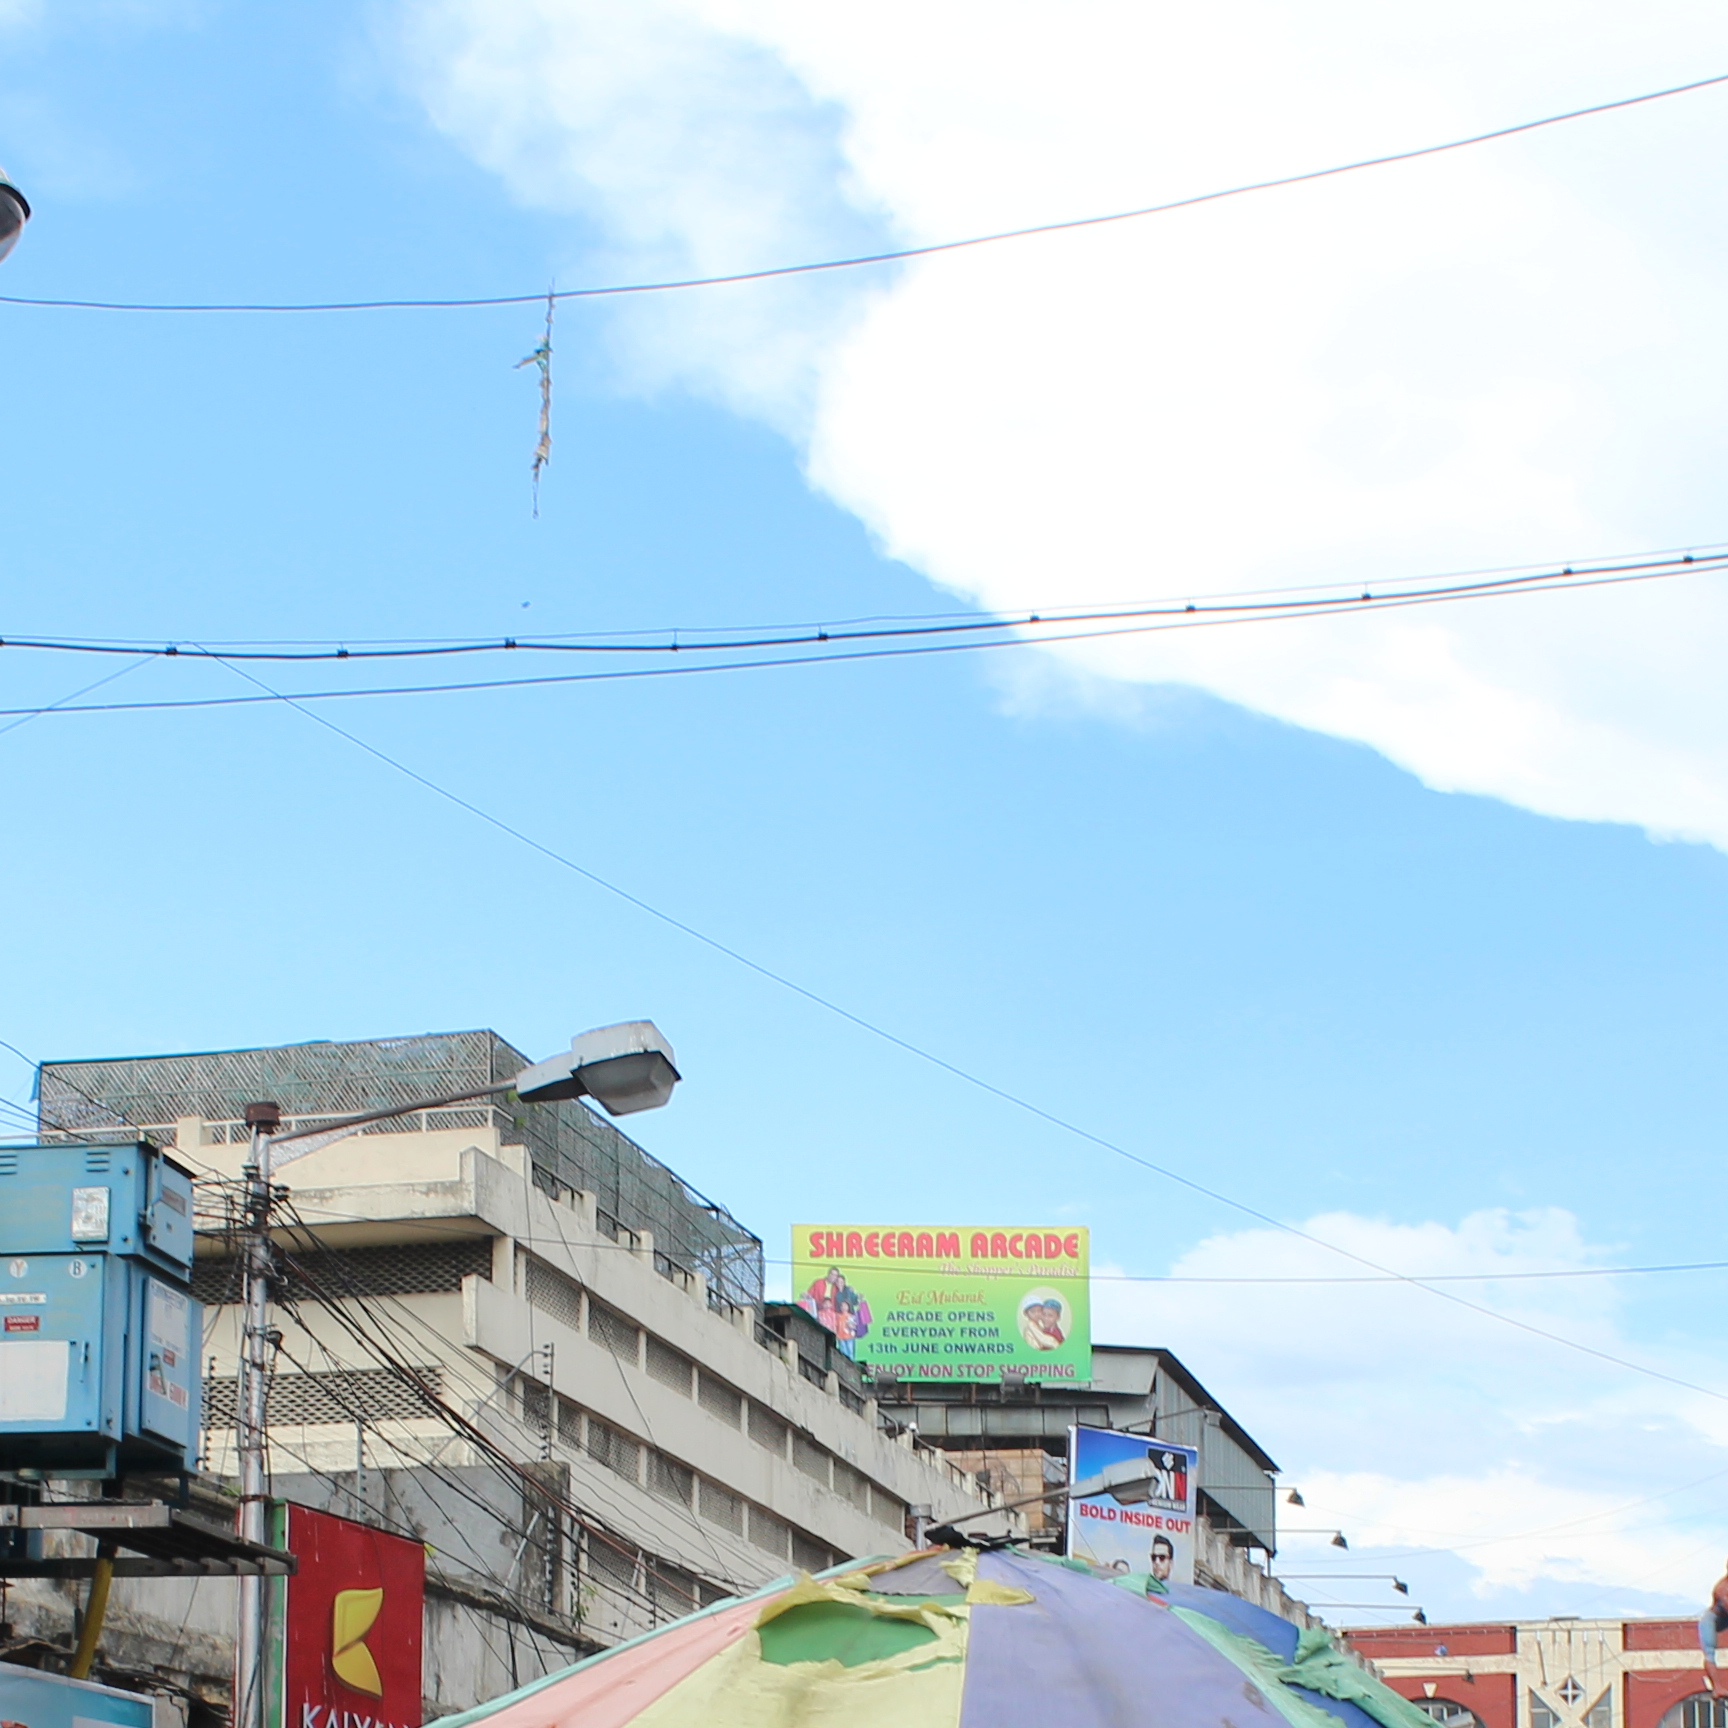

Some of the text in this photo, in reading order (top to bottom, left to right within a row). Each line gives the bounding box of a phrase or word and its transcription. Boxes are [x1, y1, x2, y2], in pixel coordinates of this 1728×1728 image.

[809, 1230, 1079, 1259] SHREERAM ARCADE
[73, 1261, 82, 1277] B
[896, 1289, 988, 1306] Eid Mubarak
[886, 1311, 995, 1322] ARCADE OPENS
[882, 1327, 999, 1338] EVERYDAY FROM
[868, 1342, 1015, 1354] 13th JUNE ONWARDS
[919, 1364, 953, 1377] NON
[957, 1364, 994, 1377] STOP
[998, 1363, 1075, 1378] SHOPPING
[1079, 1503, 1191, 1534] BOLD INSIDE OUT
